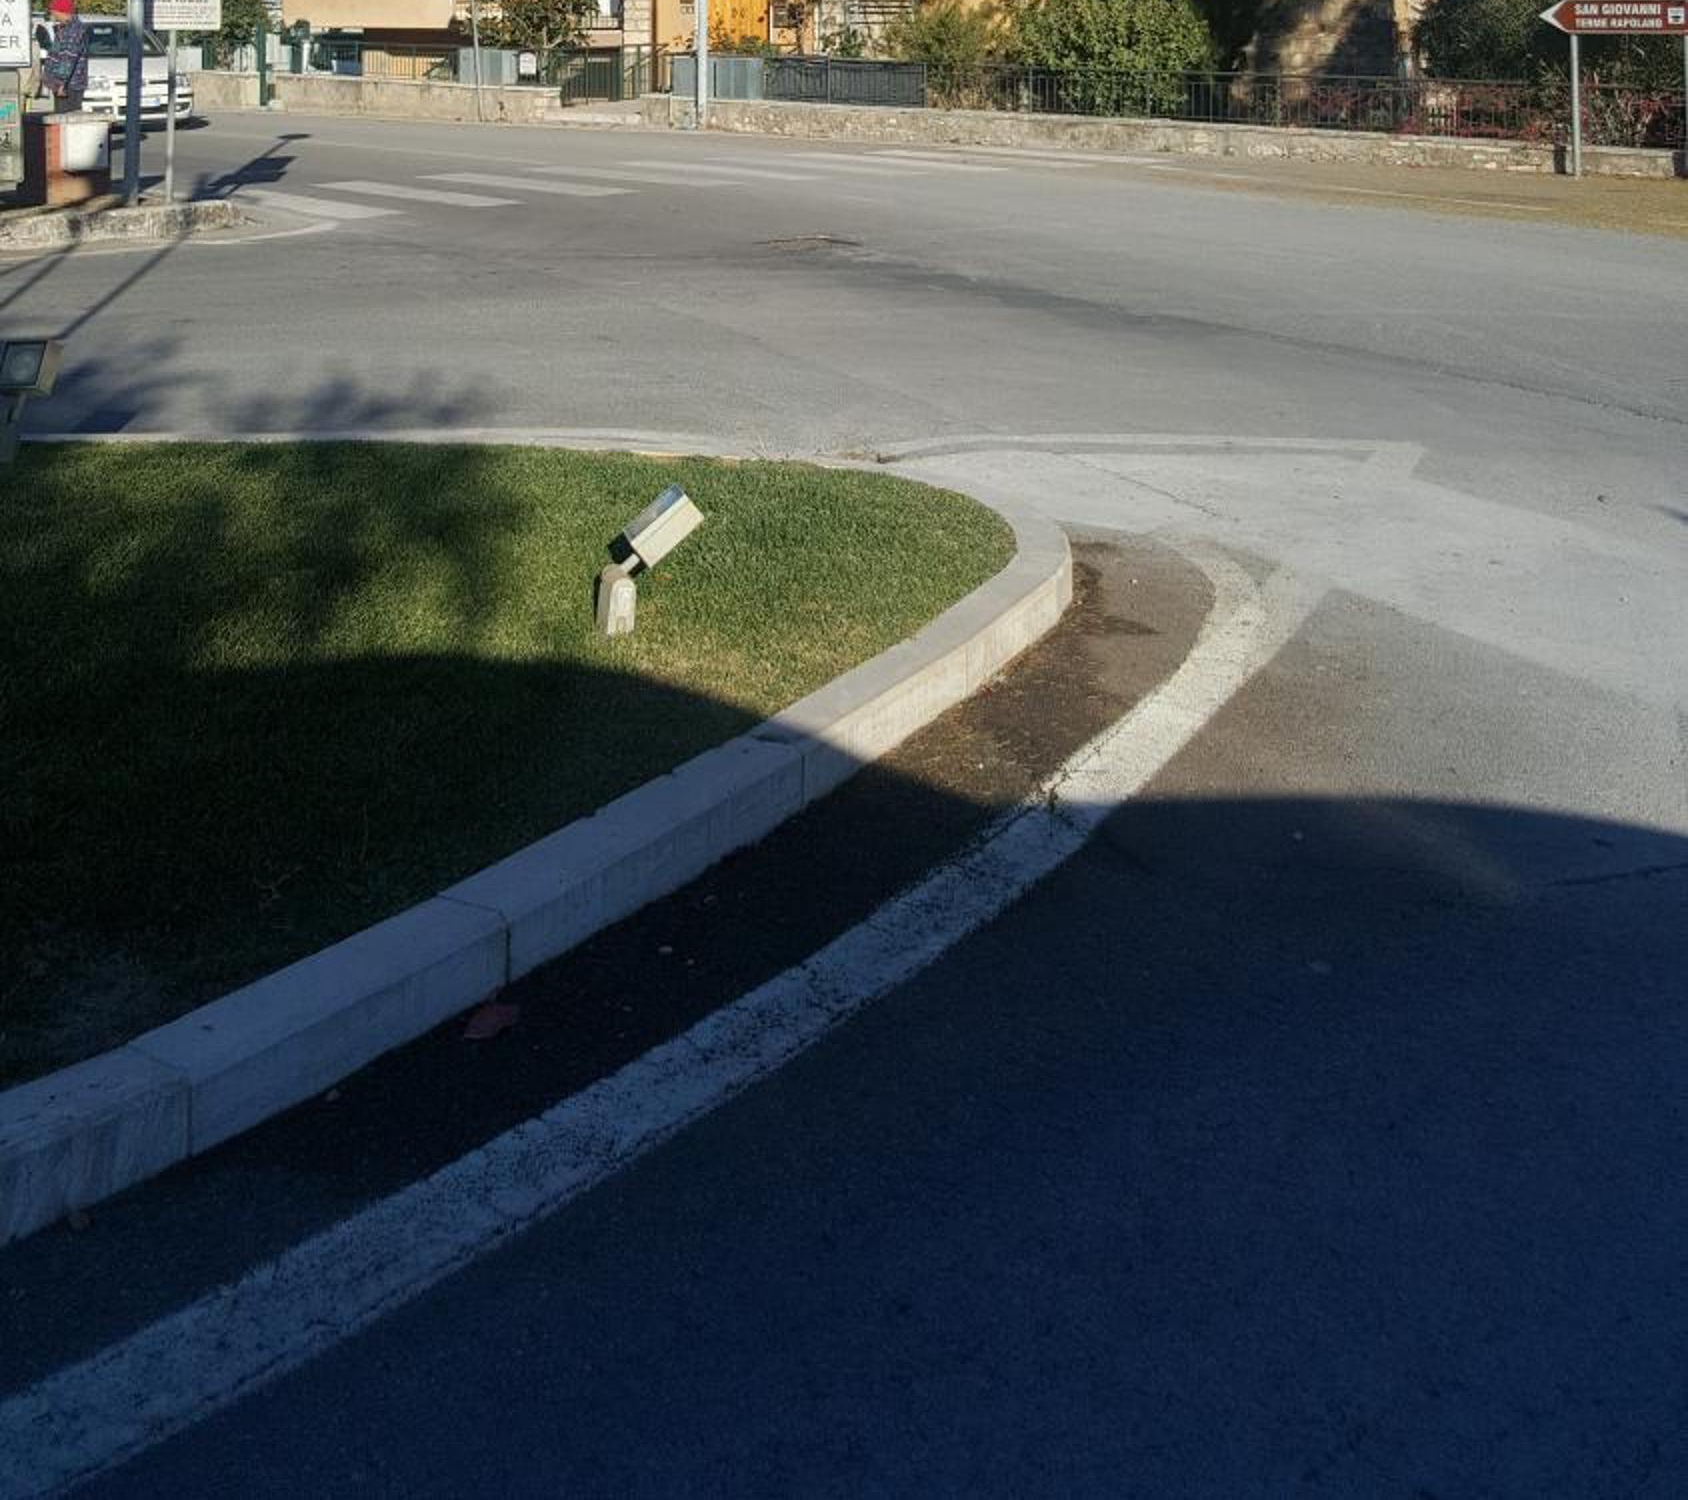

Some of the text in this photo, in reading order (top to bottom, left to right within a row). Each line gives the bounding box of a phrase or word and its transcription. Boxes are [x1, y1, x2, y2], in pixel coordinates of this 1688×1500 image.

[1574, 3, 1661, 15] SAN GIOVANNI
[1575, 17, 1663, 28] TERME RAPOLANO
